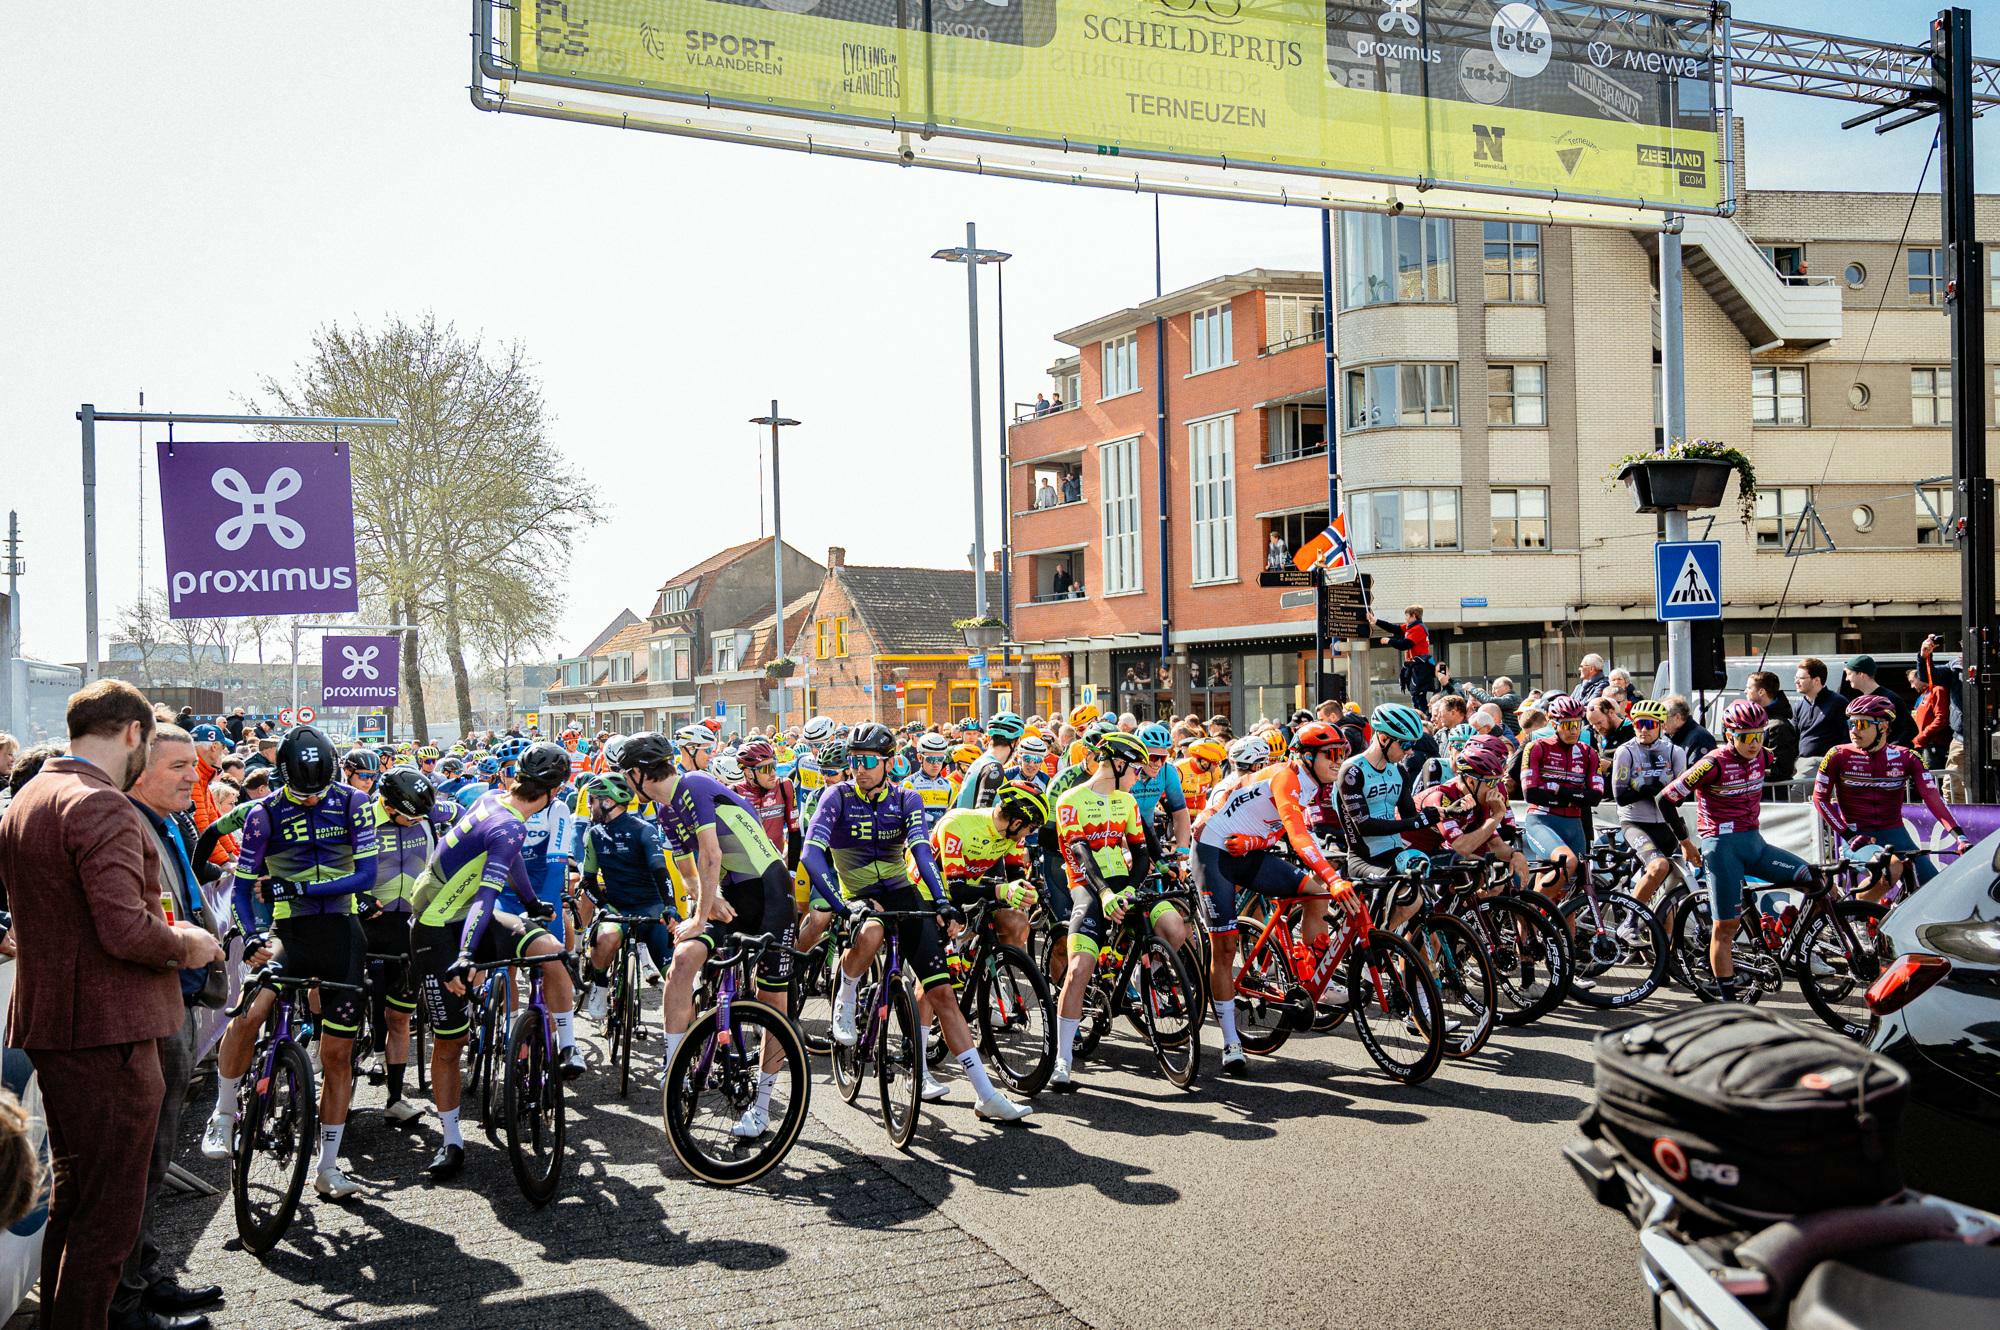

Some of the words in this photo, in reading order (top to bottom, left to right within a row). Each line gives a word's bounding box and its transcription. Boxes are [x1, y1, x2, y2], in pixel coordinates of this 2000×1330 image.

[1083, 14, 1302, 71] SCHELDEPRIJS
[1357, 40, 1442, 64] proximus
[686, 52, 783, 76] VLAANDEREN
[843, 65, 901, 99] FLANDERS
[1126, 92, 1267, 128] TERNEUZEN
[1640, 147, 1702, 168] ZEELAND
[172, 565, 353, 603] proximus
[323, 684, 398, 699] proximus
[207, 731, 216, 741] 3
[1366, 784, 1402, 799] BEAT
[1843, 779, 1904, 791] corratec
[1223, 787, 1262, 818] TREK
[735, 813, 755, 835] BLACK
[753, 834, 772, 859] SPOKE
[438, 892, 459, 914] BLACK
[456, 872, 478, 896] SPOKE
[1609, 894, 1653, 921] URSUS
[1780, 898, 1814, 961] corratec
[1799, 917, 1823, 964] URSUS
[1311, 921, 1351, 986] TREK
[1546, 936, 1561, 987] URSUS
[433, 989, 448, 1021] BOLTON
[1501, 982, 1533, 1008] URSUS
[1611, 978, 1655, 1005] URSUS
[1039, 999, 1050, 1057] URSUS
[1354, 1009, 1412, 1076] BONTRAGER
[991, 1054, 1019, 1089] URSUS
